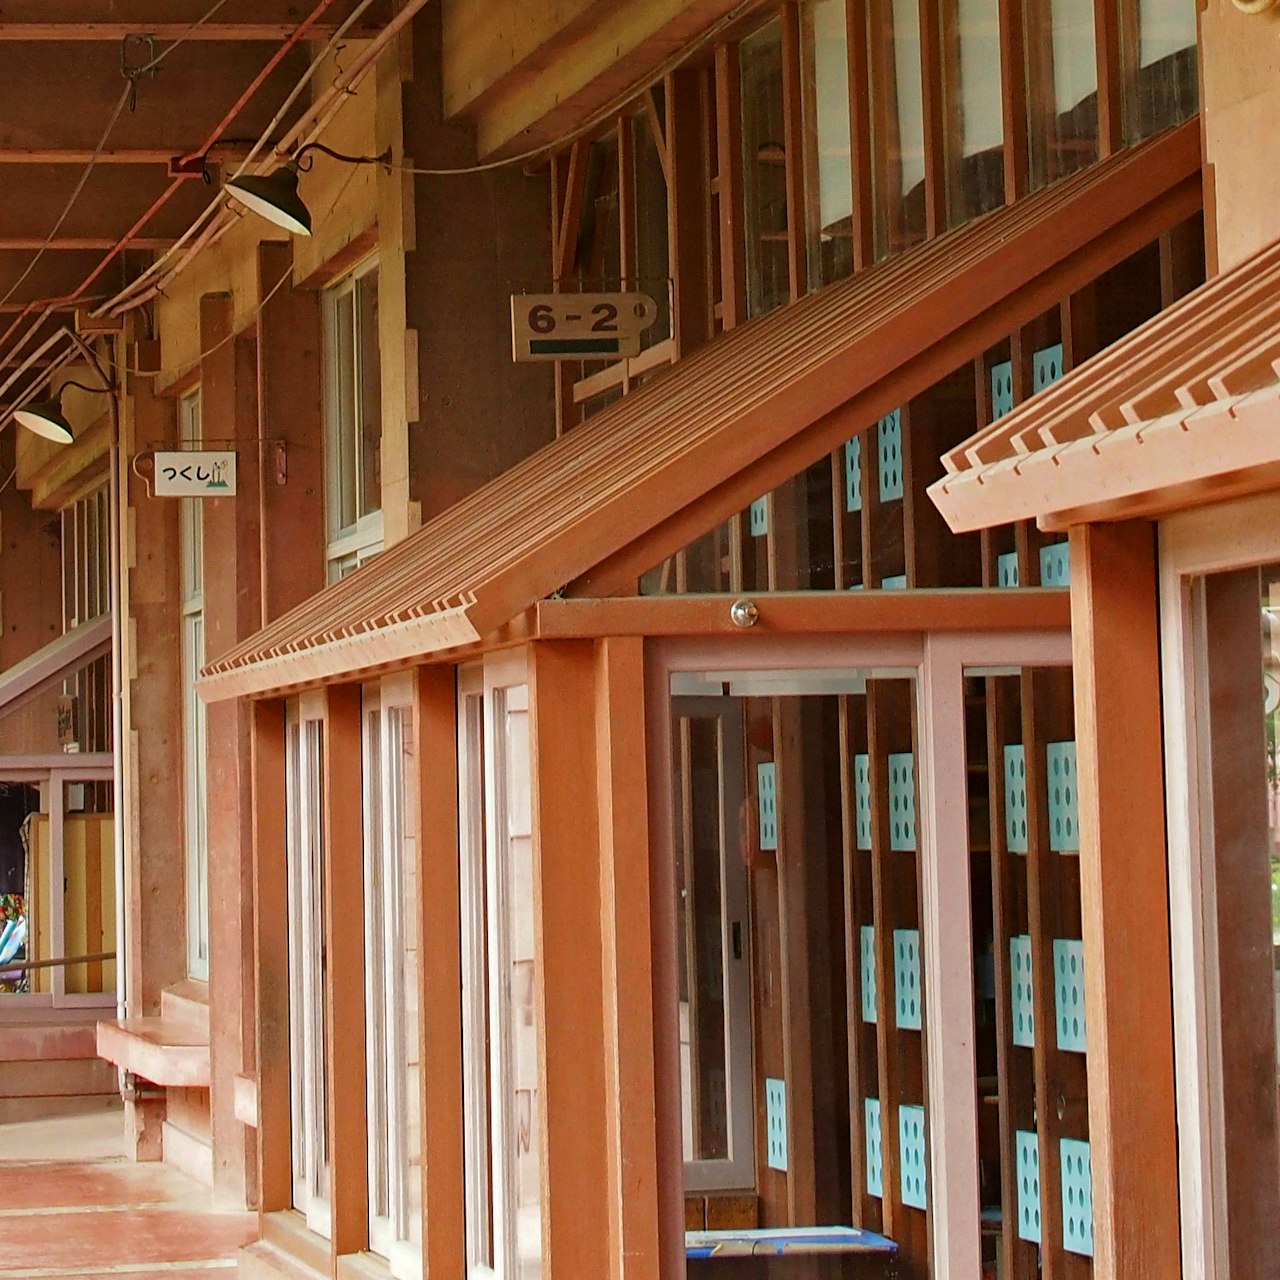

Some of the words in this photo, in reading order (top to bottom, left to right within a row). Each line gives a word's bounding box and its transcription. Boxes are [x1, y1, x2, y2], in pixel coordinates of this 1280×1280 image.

[528, 303, 618, 333] 6-2
[163, 466, 210, 482] つくし
